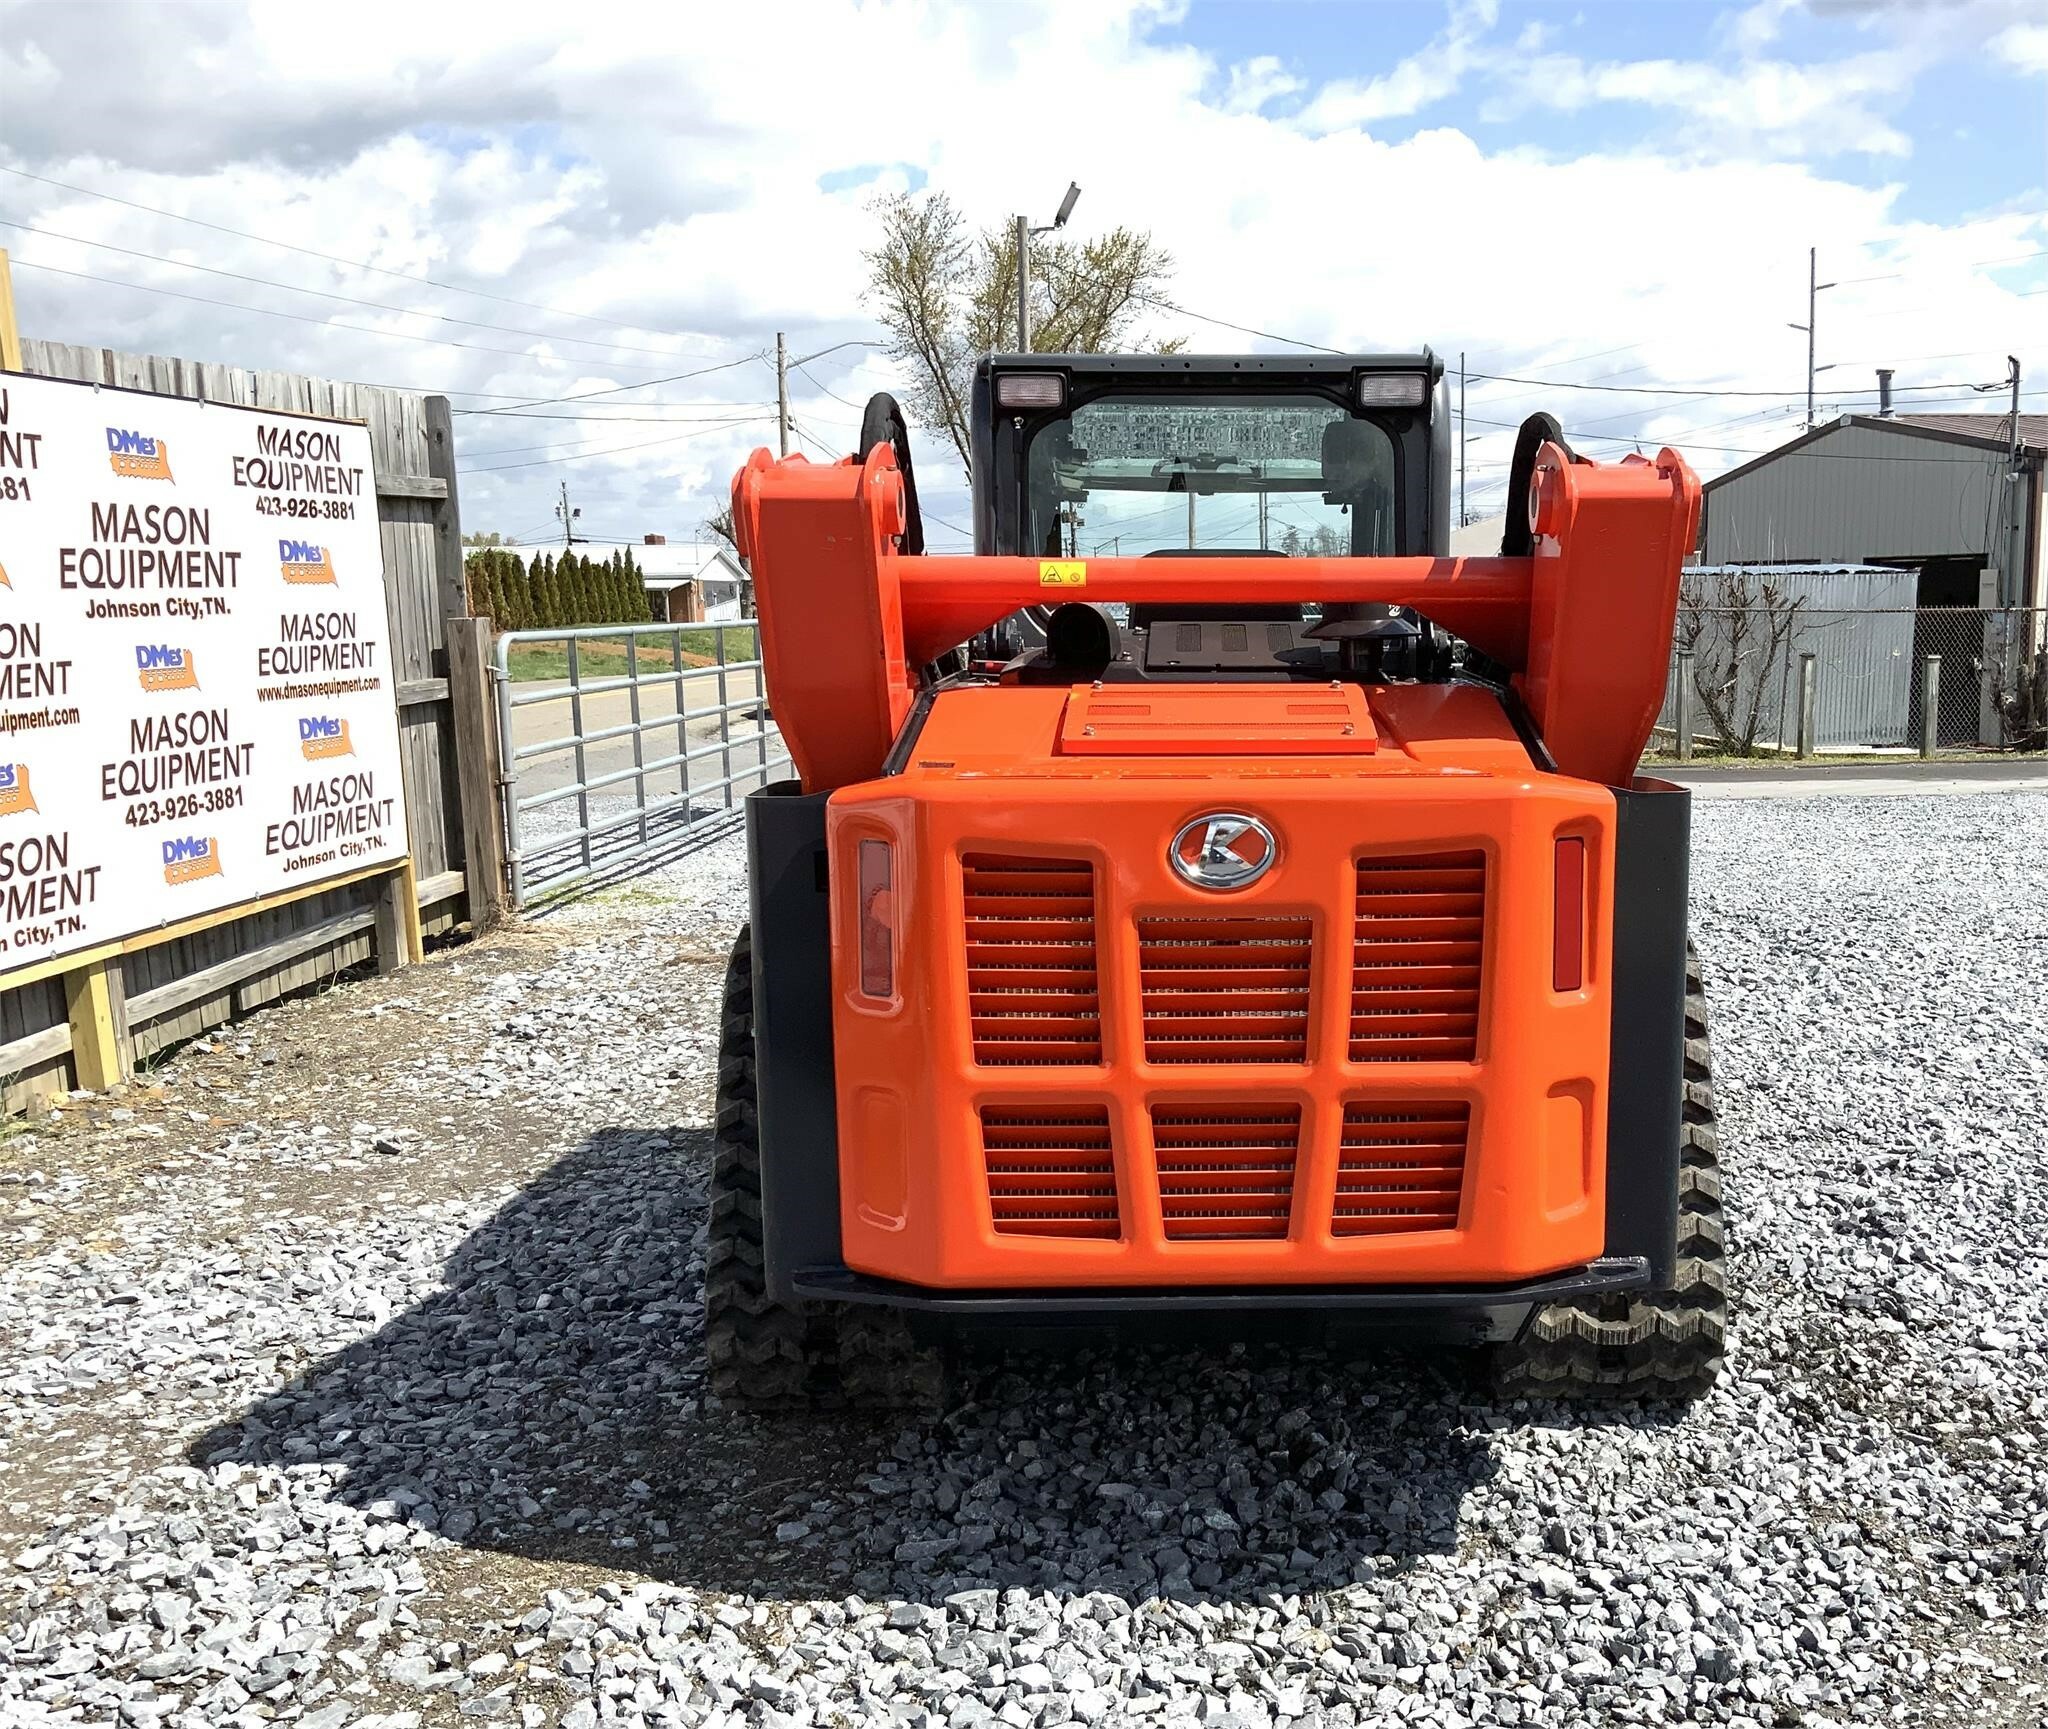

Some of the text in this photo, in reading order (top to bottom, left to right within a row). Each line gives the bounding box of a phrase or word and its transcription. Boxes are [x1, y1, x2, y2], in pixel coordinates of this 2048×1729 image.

[257, 425, 341, 462] MASON
[0, 477, 31, 501] 81
[232, 456, 363, 496] EQUIPMENT
[91, 502, 210, 546] MASON
[256, 496, 355, 521] 423-926-3881
[59, 548, 242, 590] EQUIPMENT
[86, 599, 161, 619] Johnson
[281, 613, 357, 643] MASON
[258, 642, 376, 677] EQUIPMENT
[257, 677, 380, 703] www.dmasonequipment.com
[130, 708, 229, 755] MASON
[101, 743, 255, 802] EQUIPMENT
[125, 785, 243, 828] 423-926-3881
[293, 771, 373, 816] MASON
[265, 799, 395, 856] EQUIPMENT
[283, 849, 336, 873] Johnson
[0, 866, 101, 923] MENT
